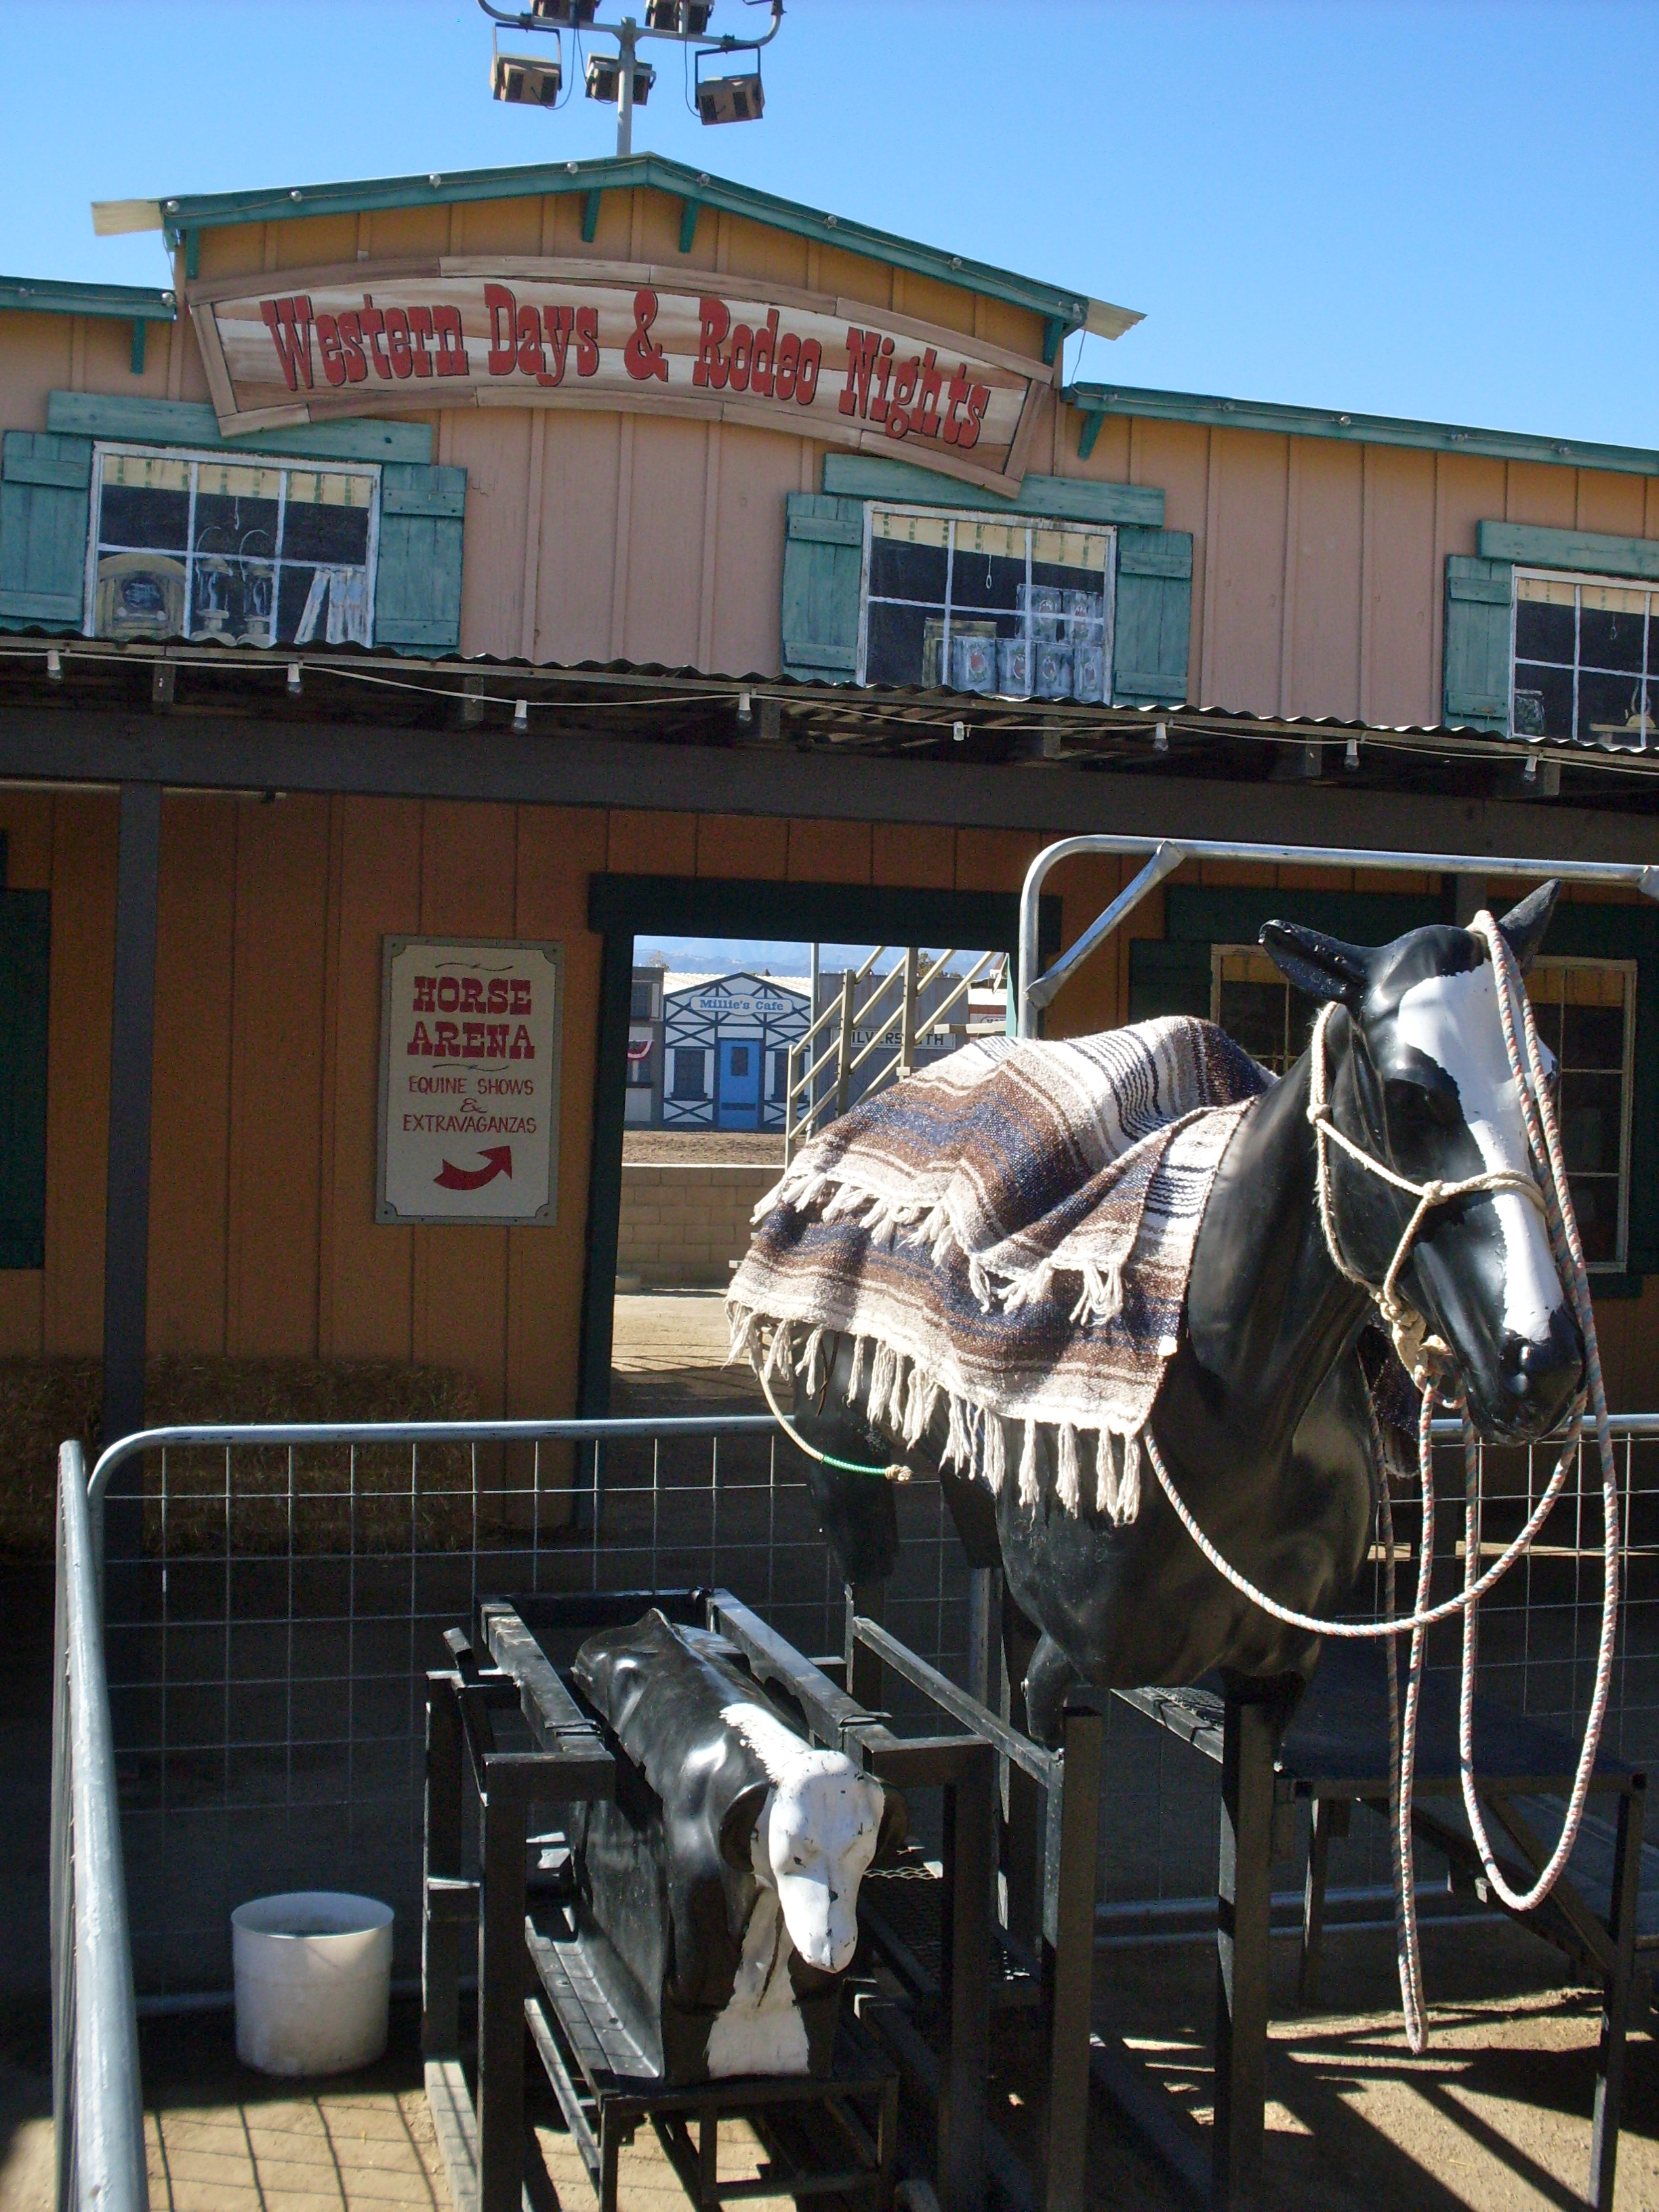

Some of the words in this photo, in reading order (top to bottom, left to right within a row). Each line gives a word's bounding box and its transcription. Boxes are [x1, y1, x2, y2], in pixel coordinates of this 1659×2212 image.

[260, 293, 470, 391] Western
[483, 283, 600, 386] Days
[623, 289, 669, 382] &
[692, 297, 822, 405] Rodeo
[838, 326, 991, 449] Nights
[412, 976, 531, 1015] HORSE
[700, 999, 750, 1010] Millie's
[755, 1001, 784, 1010] Cafe
[407, 1021, 535, 1059] ARENA
[852, 1031, 944, 1046] ILVRSTH
[409, 1076, 467, 1094] EQUINE
[477, 1078, 534, 1095] SHOWS
[459, 1097, 487, 1113] &
[403, 1113, 537, 1134] EXTRAVAGANZAS
